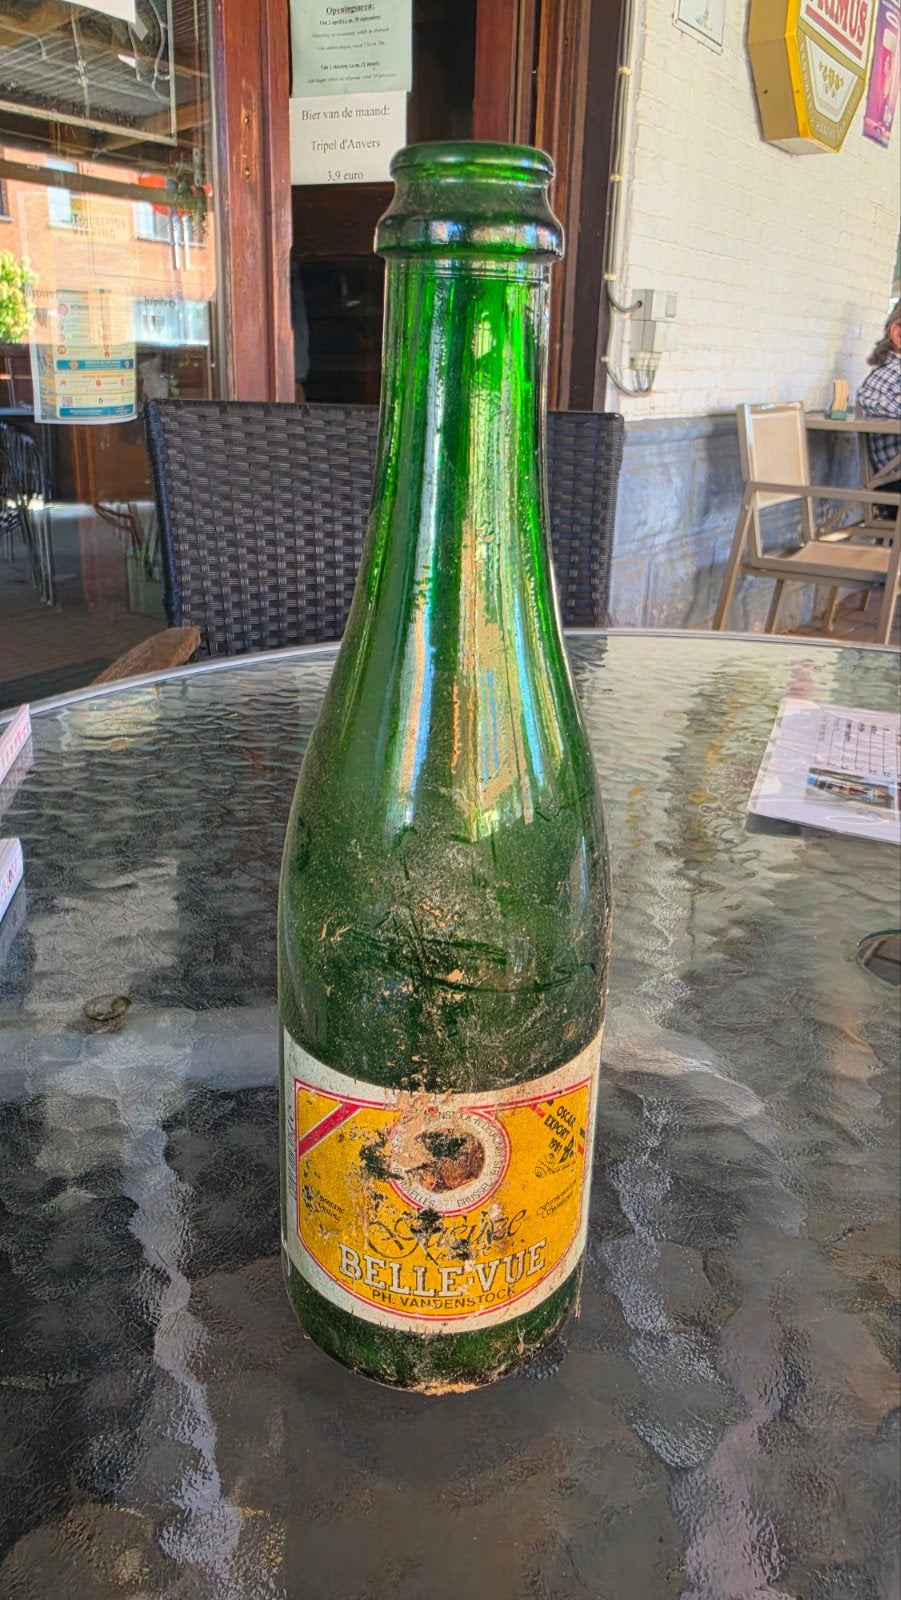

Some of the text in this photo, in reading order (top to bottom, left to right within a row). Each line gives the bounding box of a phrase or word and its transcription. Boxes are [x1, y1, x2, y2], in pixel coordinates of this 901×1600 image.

[302, 105, 390, 121] Bier van de maand:
[310, 138, 381, 154] Tripel d'Anvers
[343, 172, 364, 181] euro
[544, 1114, 571, 1140] EXPORT
[371, 1285, 517, 1310] PH. VANDENSTOCK
